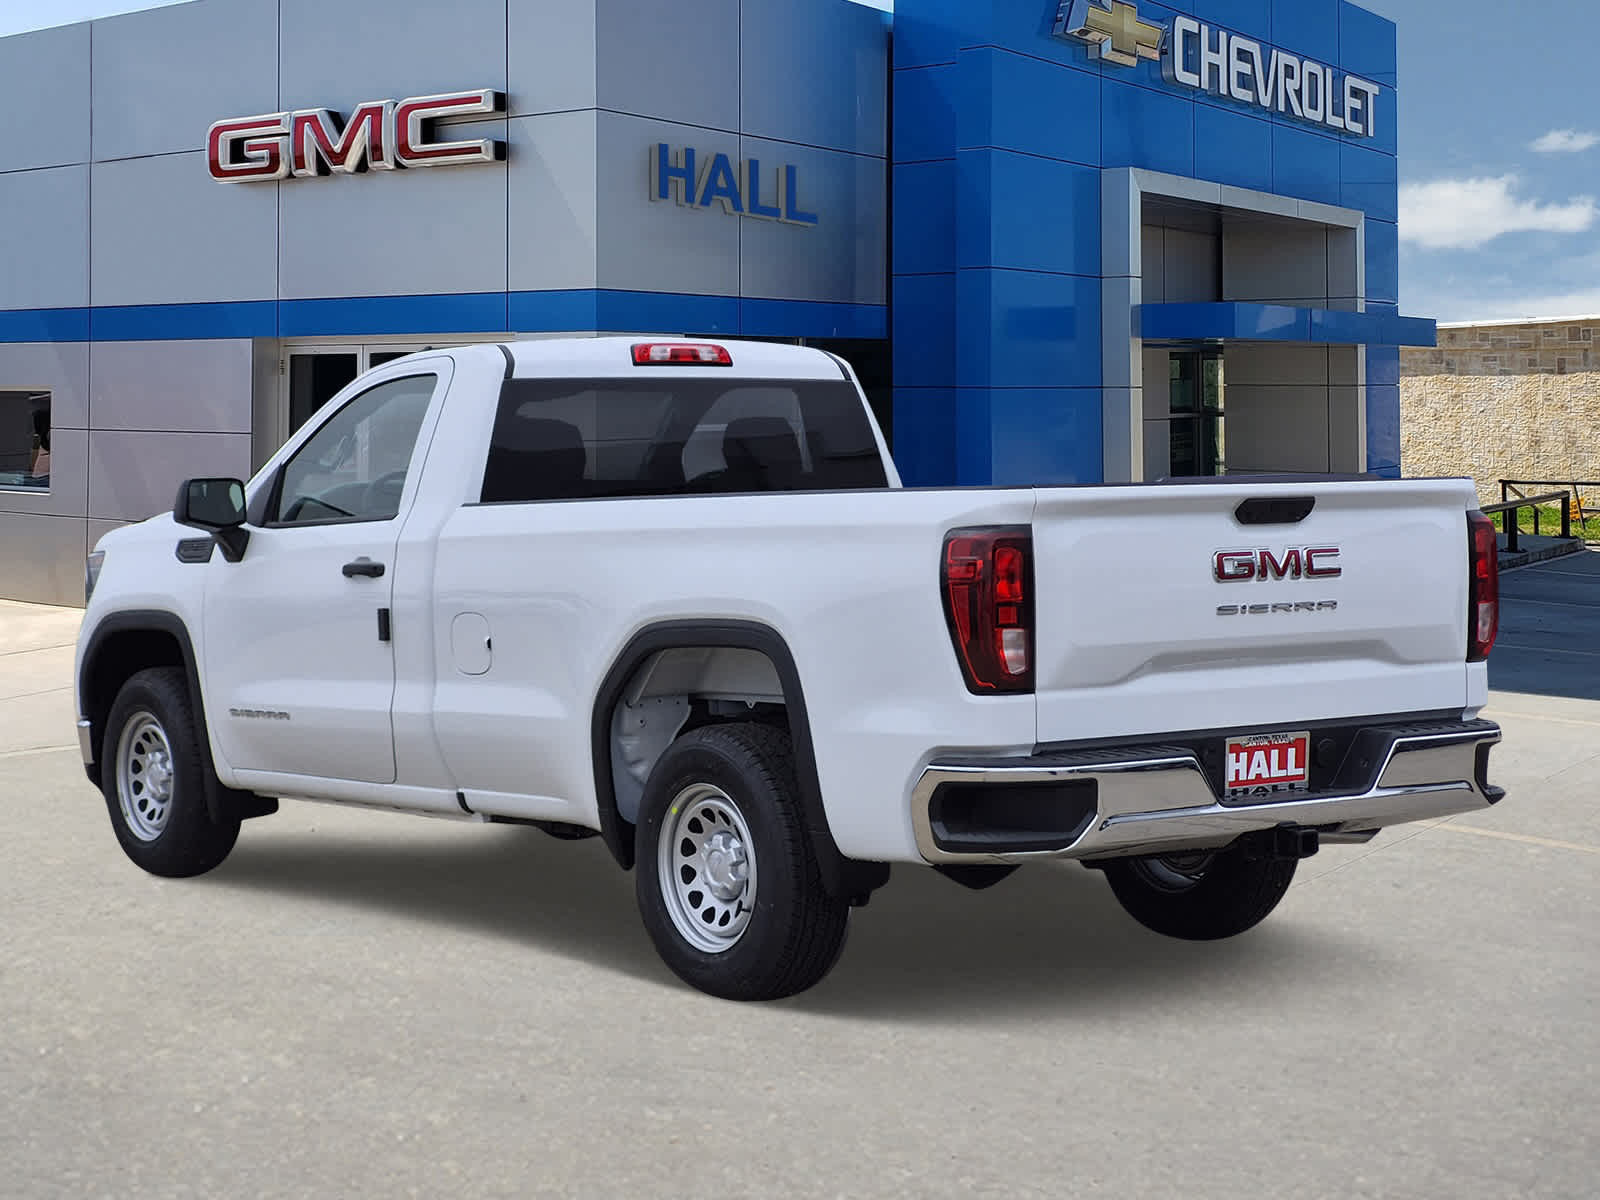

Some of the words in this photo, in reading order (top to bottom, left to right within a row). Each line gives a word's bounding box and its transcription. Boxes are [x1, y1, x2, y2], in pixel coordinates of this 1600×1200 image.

[1174, 15, 1380, 137] CHEVROLET
[205, 87, 508, 184] GMC
[650, 142, 819, 227] HALL
[1213, 545, 1342, 583] GMC
[1217, 600, 1338, 616] SIERRA
[229, 708, 291, 721] SIERRA
[1228, 747, 1304, 782] HALL
